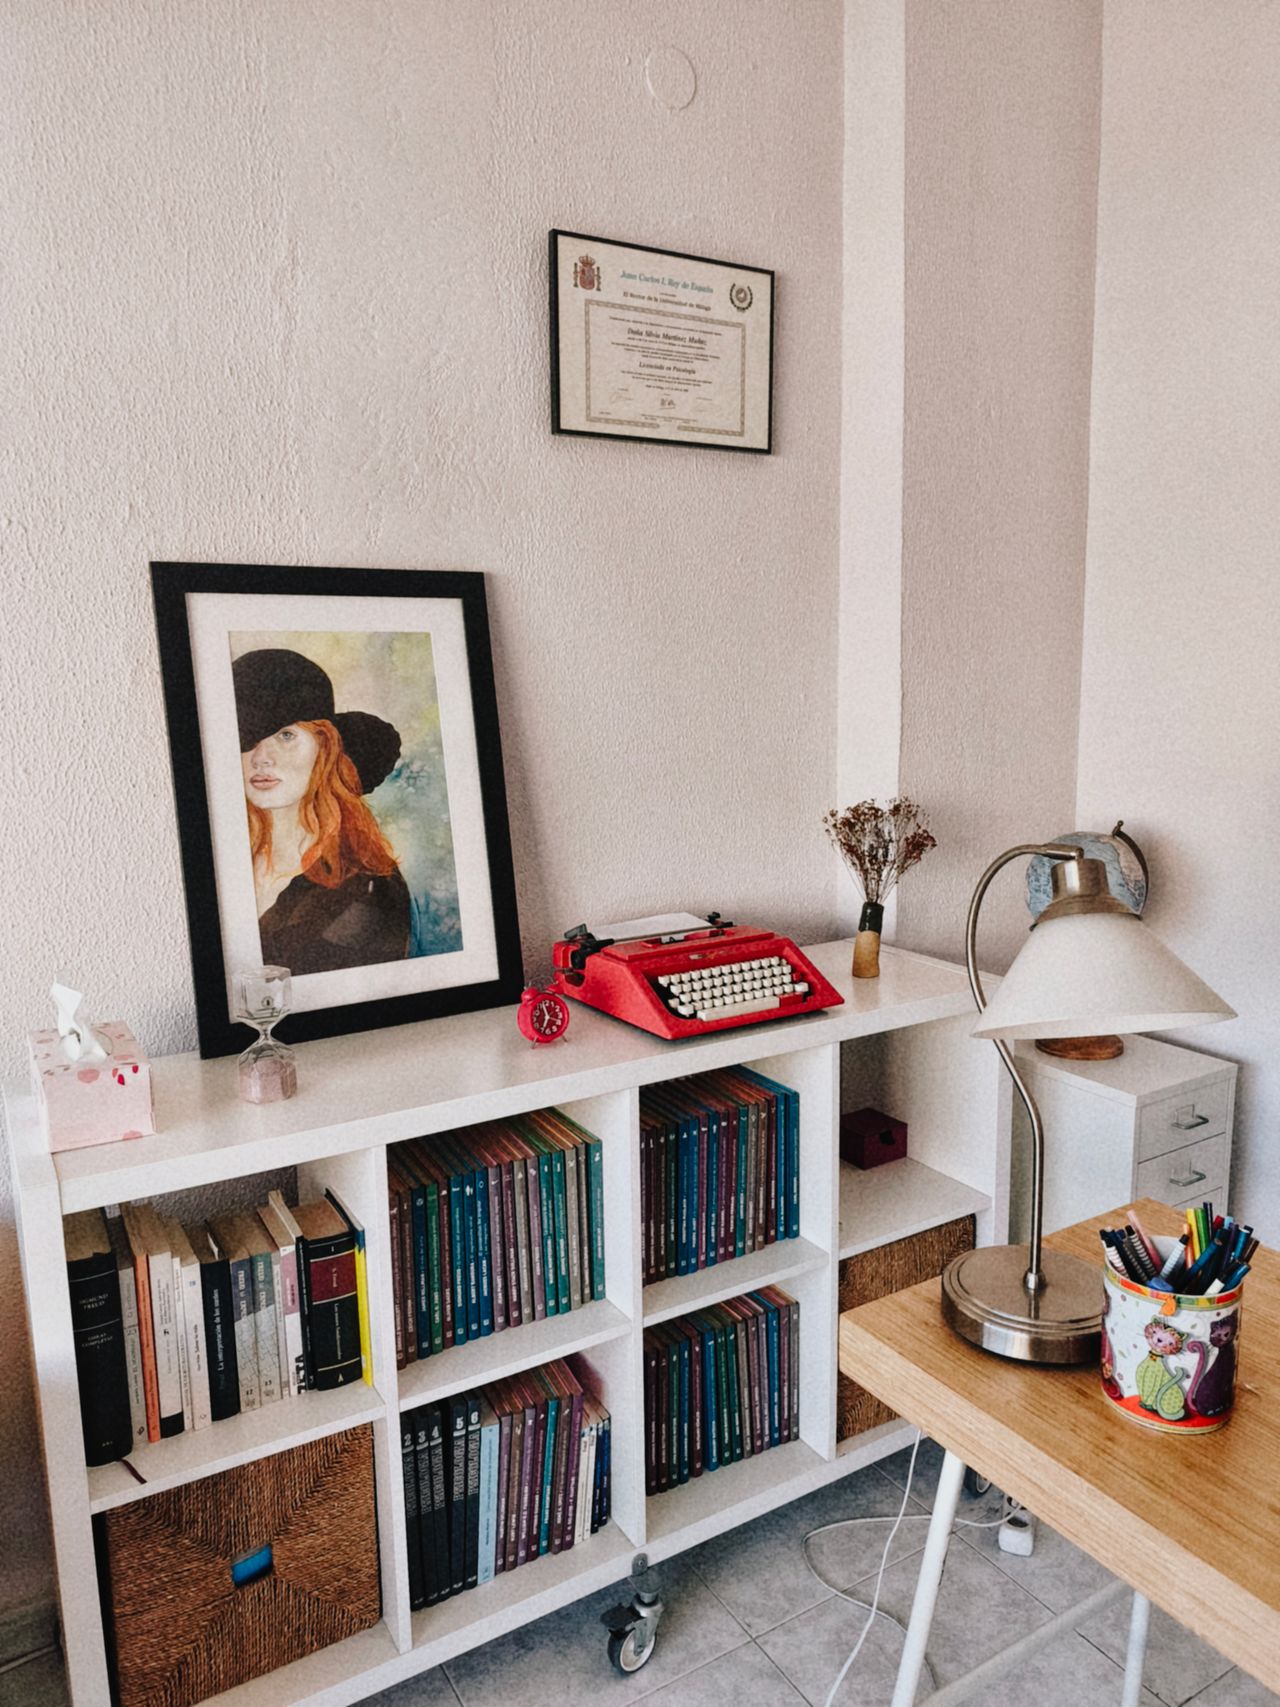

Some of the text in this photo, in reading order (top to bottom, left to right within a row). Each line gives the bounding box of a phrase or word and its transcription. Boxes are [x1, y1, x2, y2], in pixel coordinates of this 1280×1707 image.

[214, 1316, 221, 1324] de
[216, 1324, 225, 1361] interpretación
[217, 1361, 225, 1371] La
[455, 1416, 464, 1430] 5
[470, 1411, 479, 1424] 6
[418, 1430, 426, 1443] 3
[432, 1425, 440, 1439] 4
[404, 1433, 411, 1446] 2
